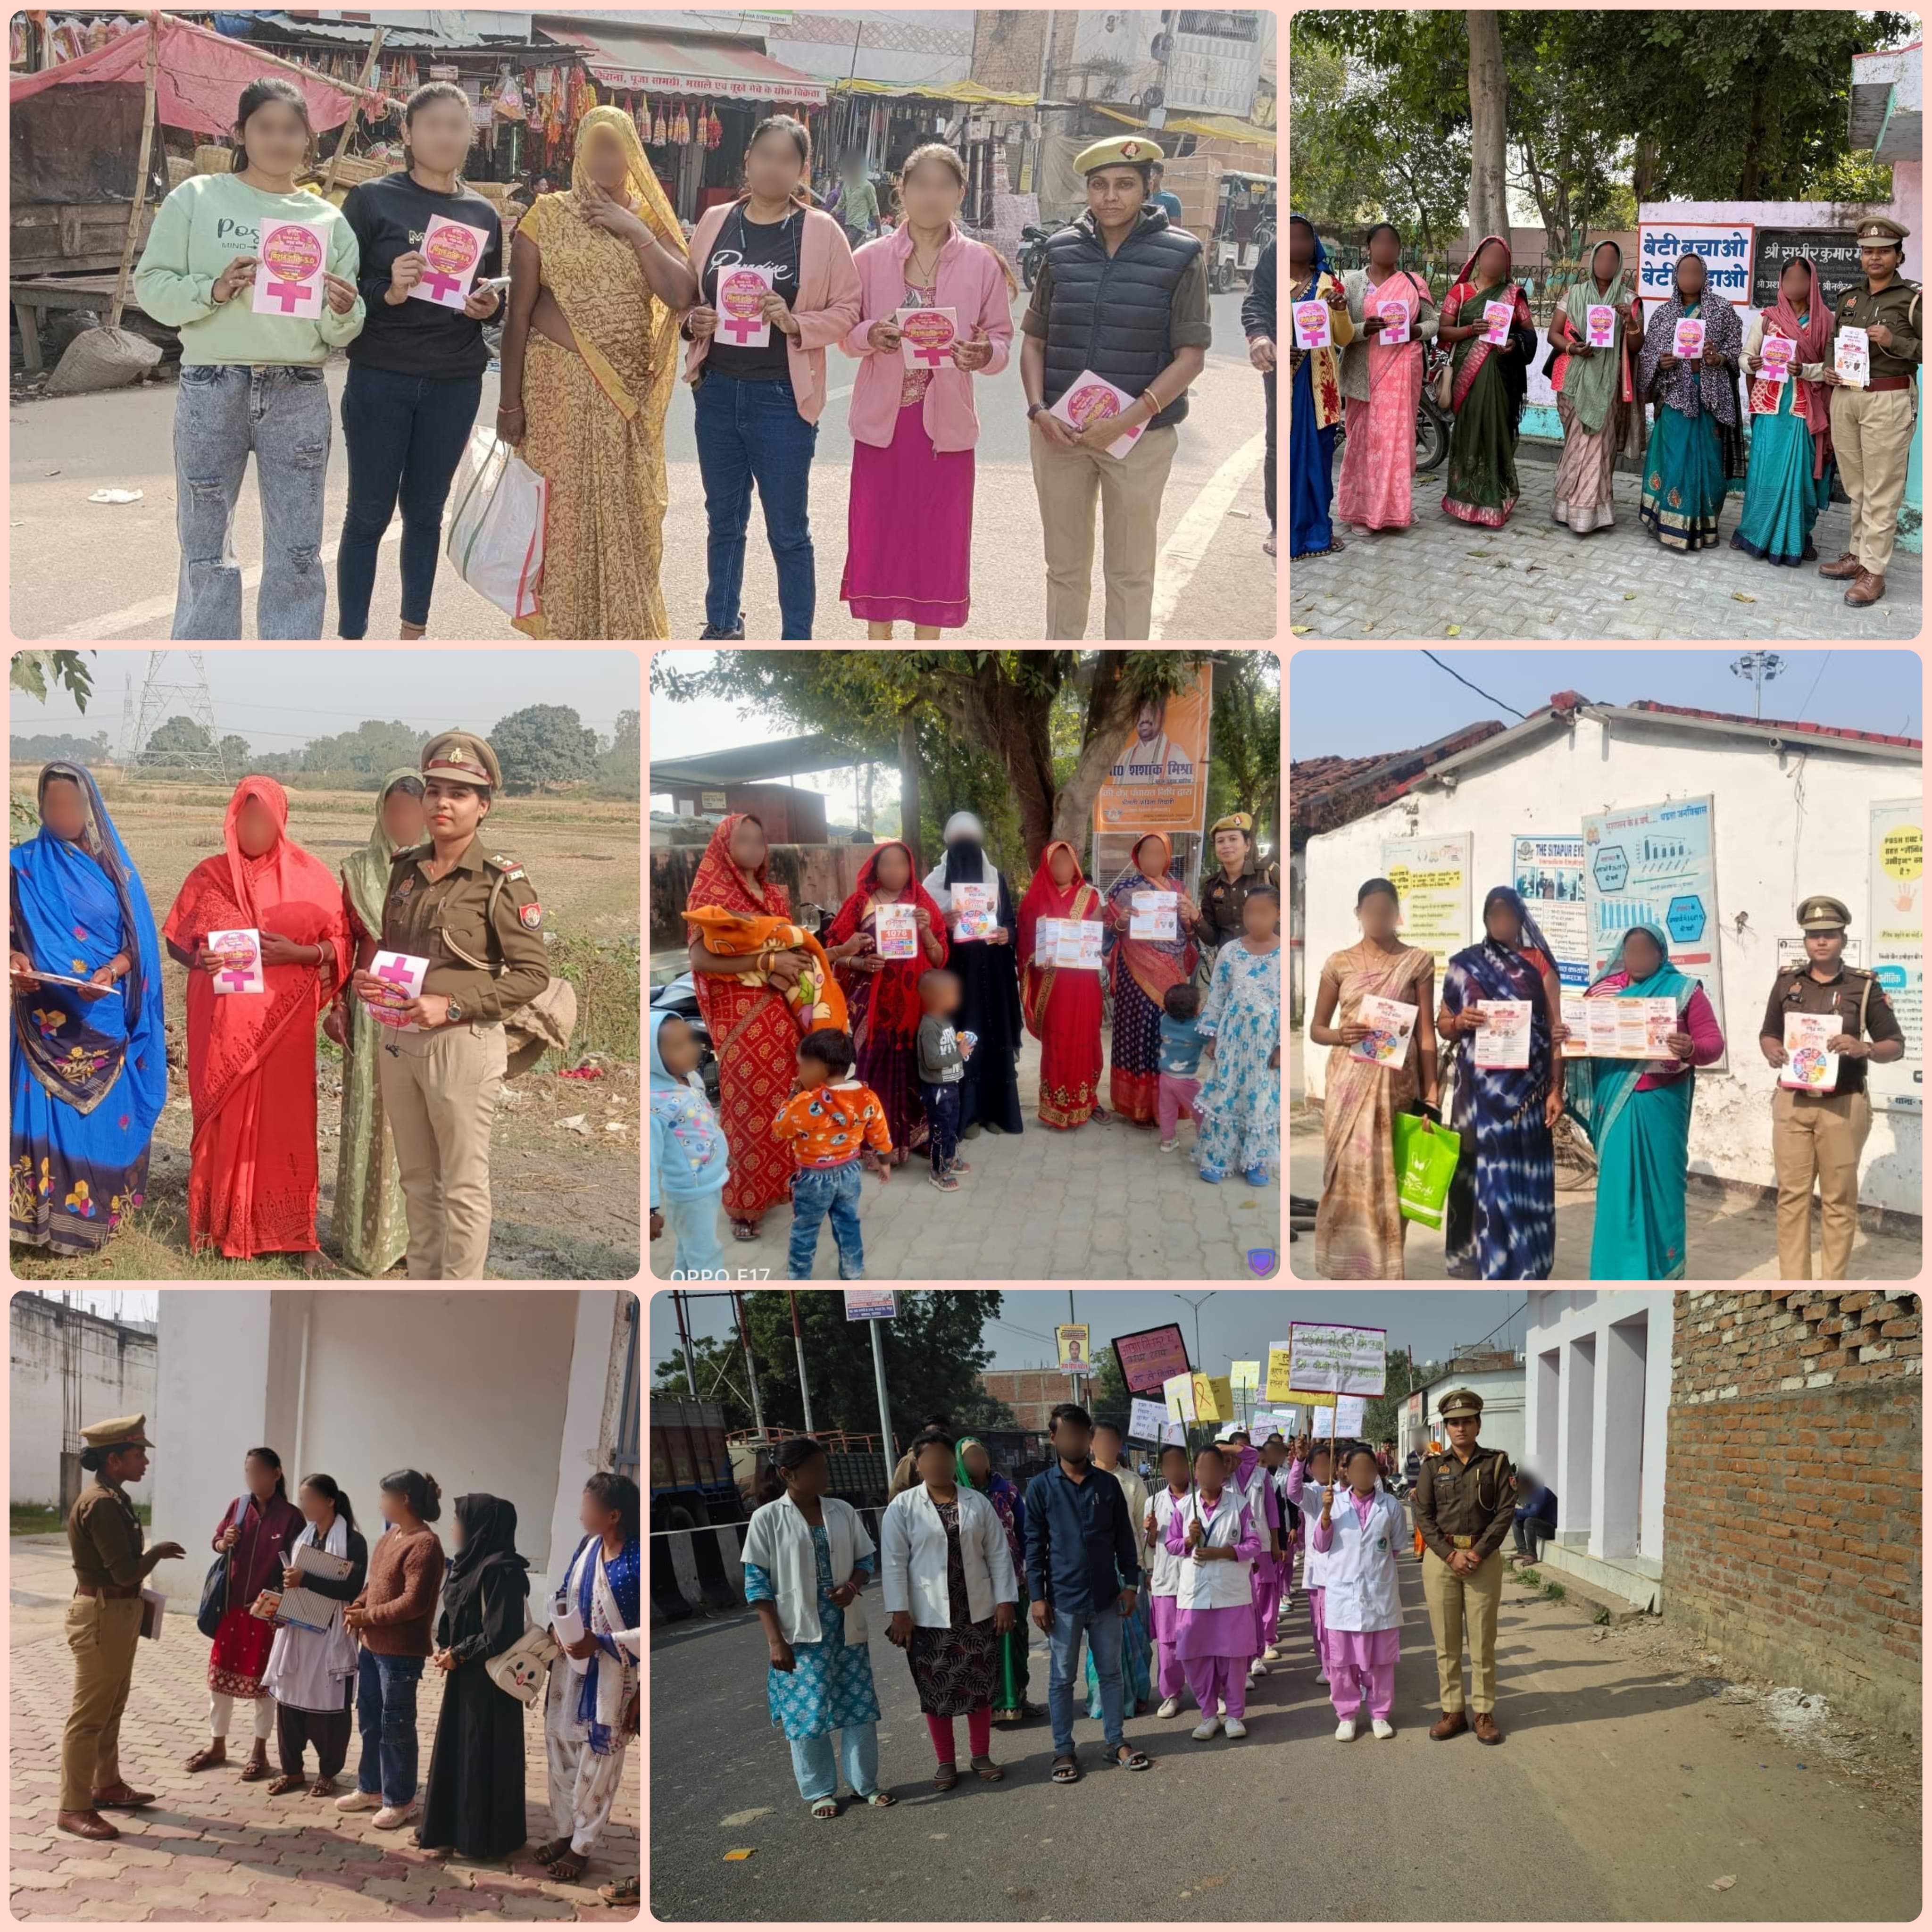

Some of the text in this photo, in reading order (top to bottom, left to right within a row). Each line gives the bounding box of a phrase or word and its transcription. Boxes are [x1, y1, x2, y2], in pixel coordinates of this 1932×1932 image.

[1643, 231, 1749, 258] बेटी बचाओ
[1764, 242, 1779, 259] श्री
[1536, 843, 1547, 857] THE
[887, 929, 907, 937] 1076
